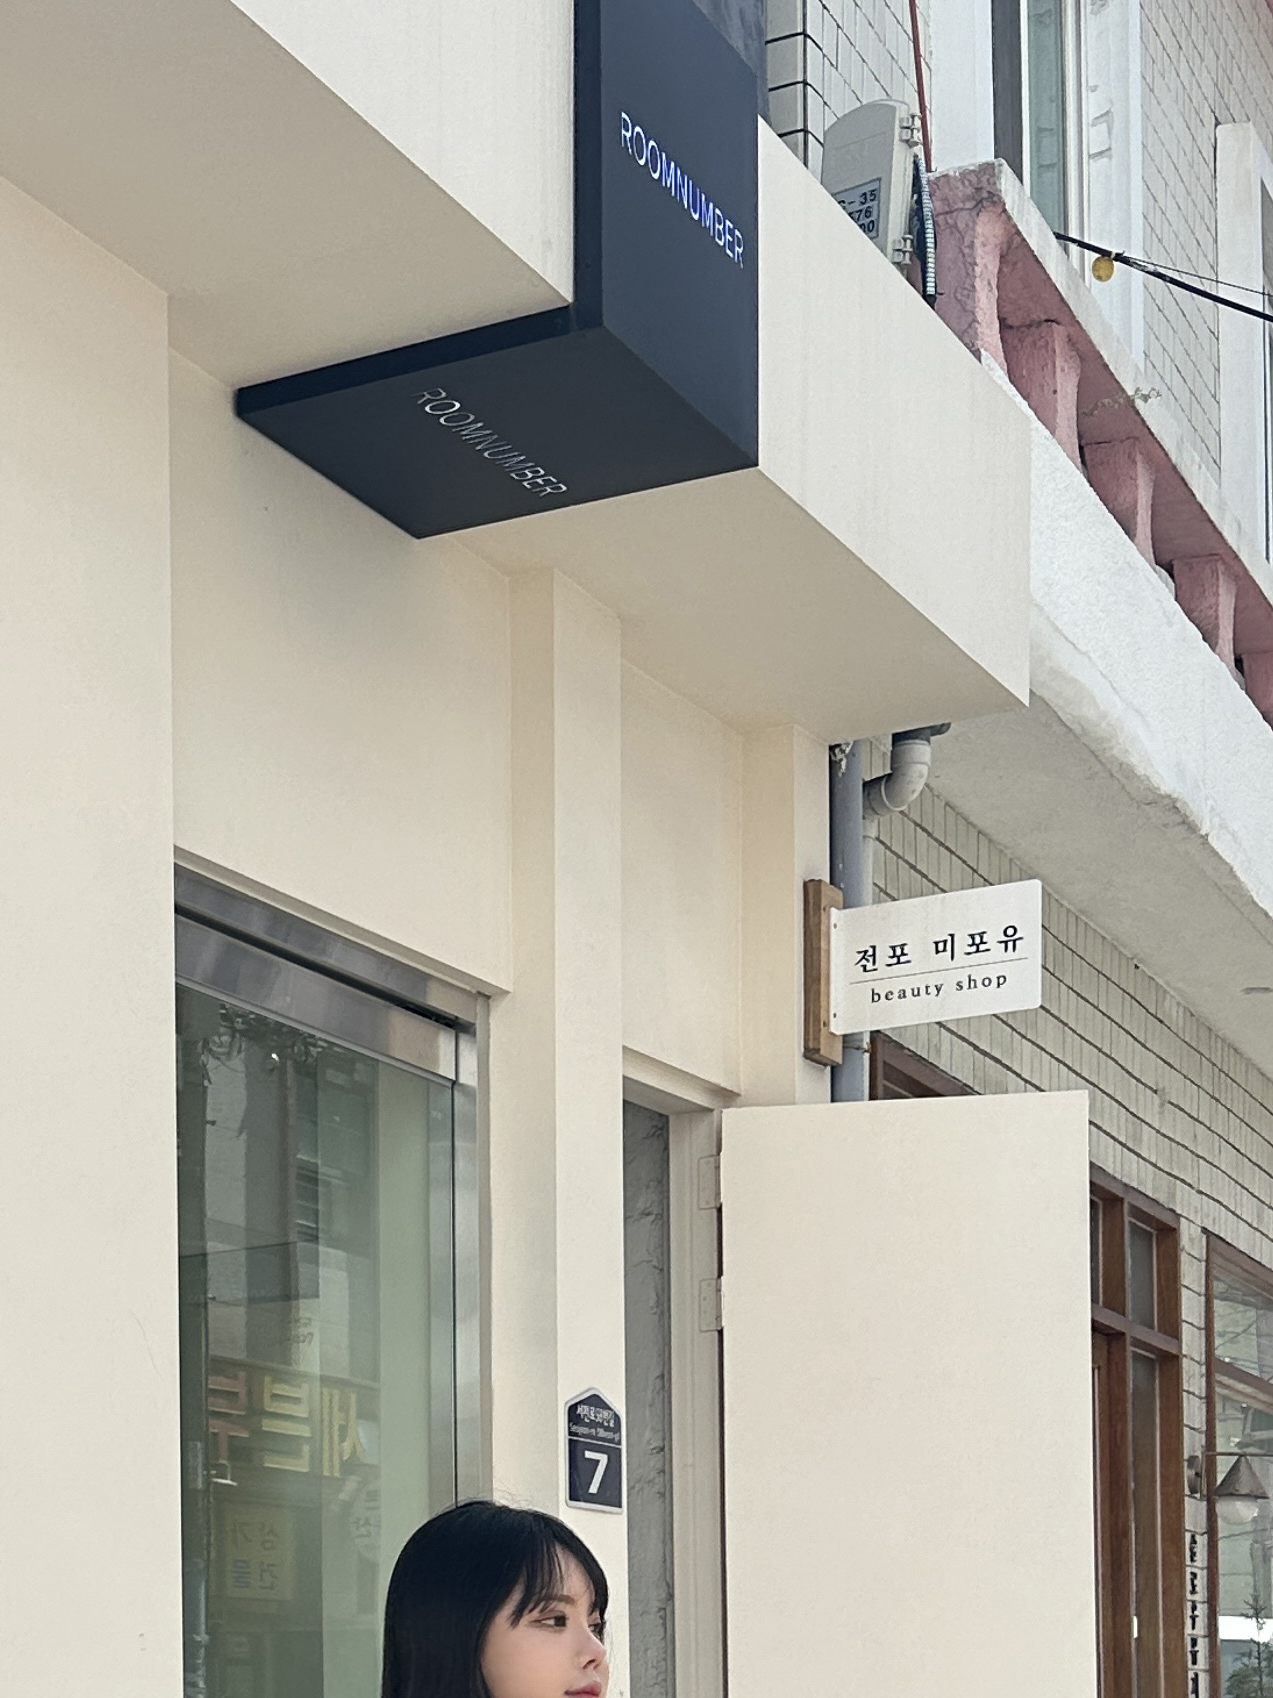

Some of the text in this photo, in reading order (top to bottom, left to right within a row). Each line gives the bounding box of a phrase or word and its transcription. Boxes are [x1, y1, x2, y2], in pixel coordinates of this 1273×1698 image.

[620, 110, 745, 269] ROOMNUMBER
[413, 387, 567, 498] ROOMNUMBER
[854, 924, 1025, 974] 전포 미포유
[871, 973, 1008, 1004] beauty shop
[584, 1450, 608, 1494] 7
